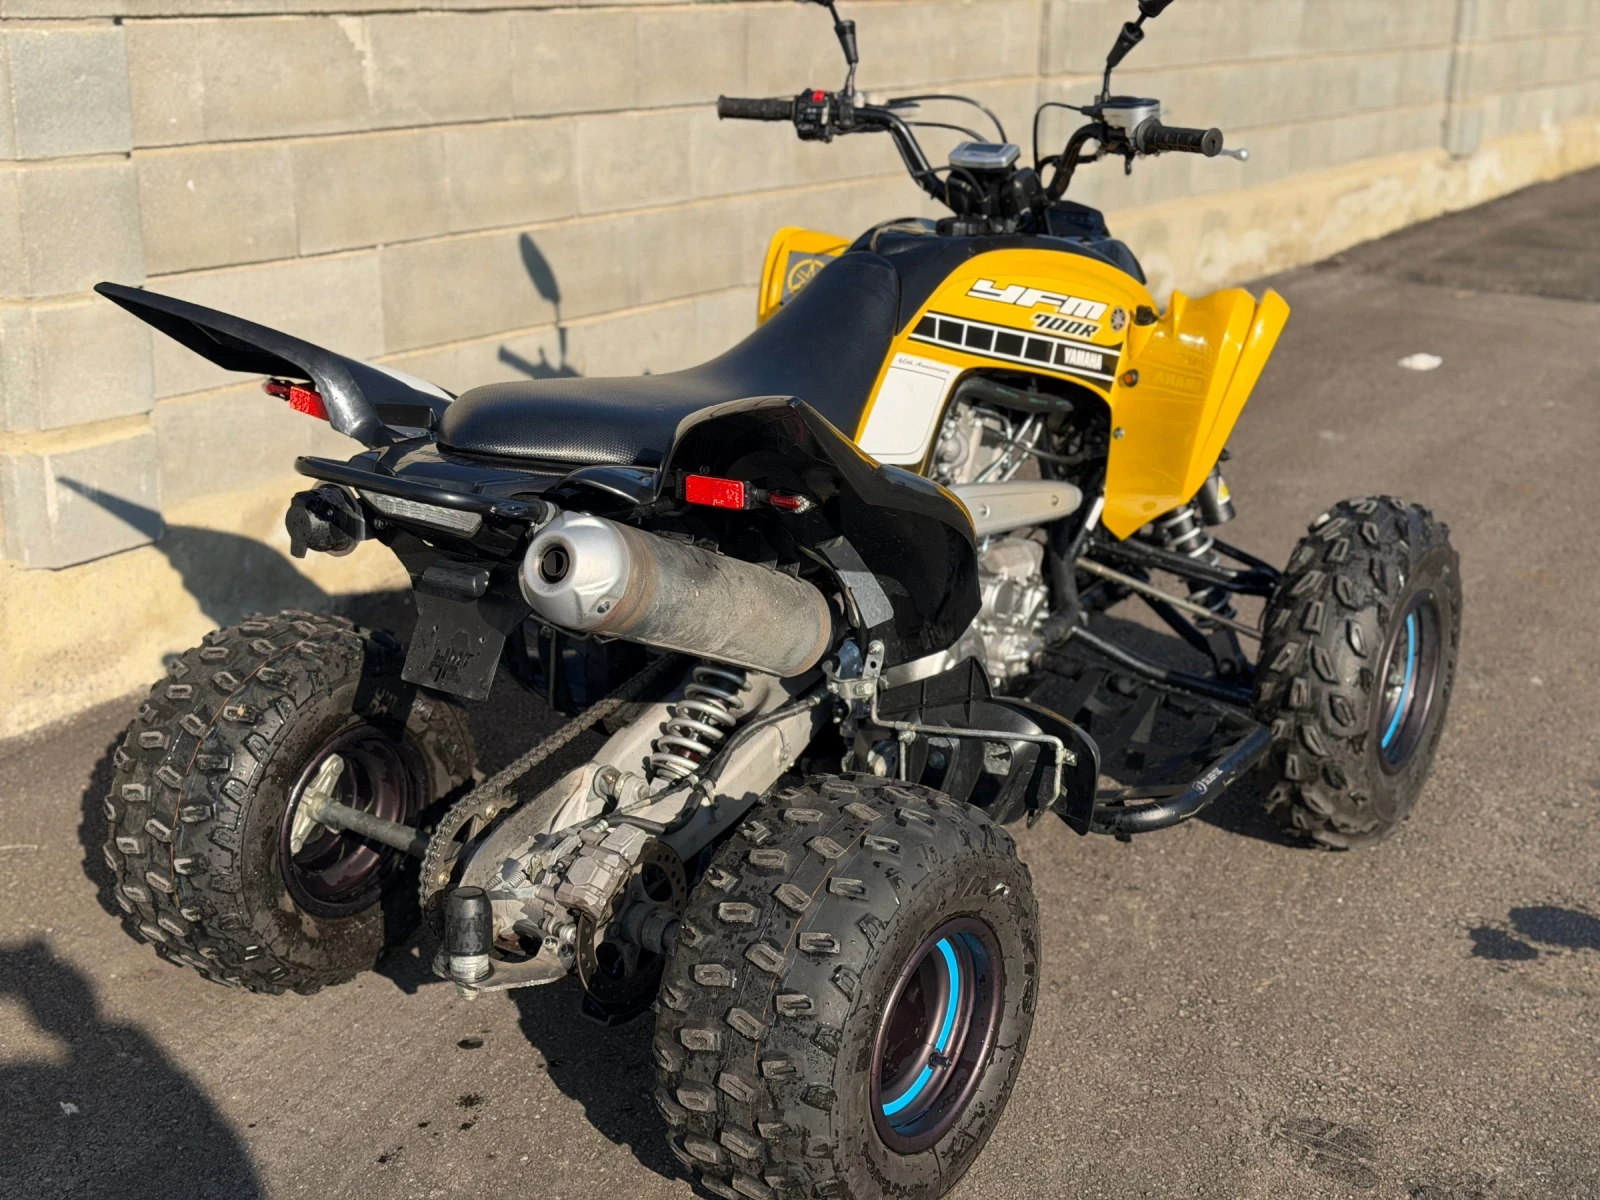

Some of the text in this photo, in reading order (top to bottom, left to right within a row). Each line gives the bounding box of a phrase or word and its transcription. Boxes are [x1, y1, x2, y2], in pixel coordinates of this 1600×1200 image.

[965, 278, 1109, 321] YFM
[1033, 312, 1100, 338] 700R
[1063, 347, 1103, 371] YAMAHA
